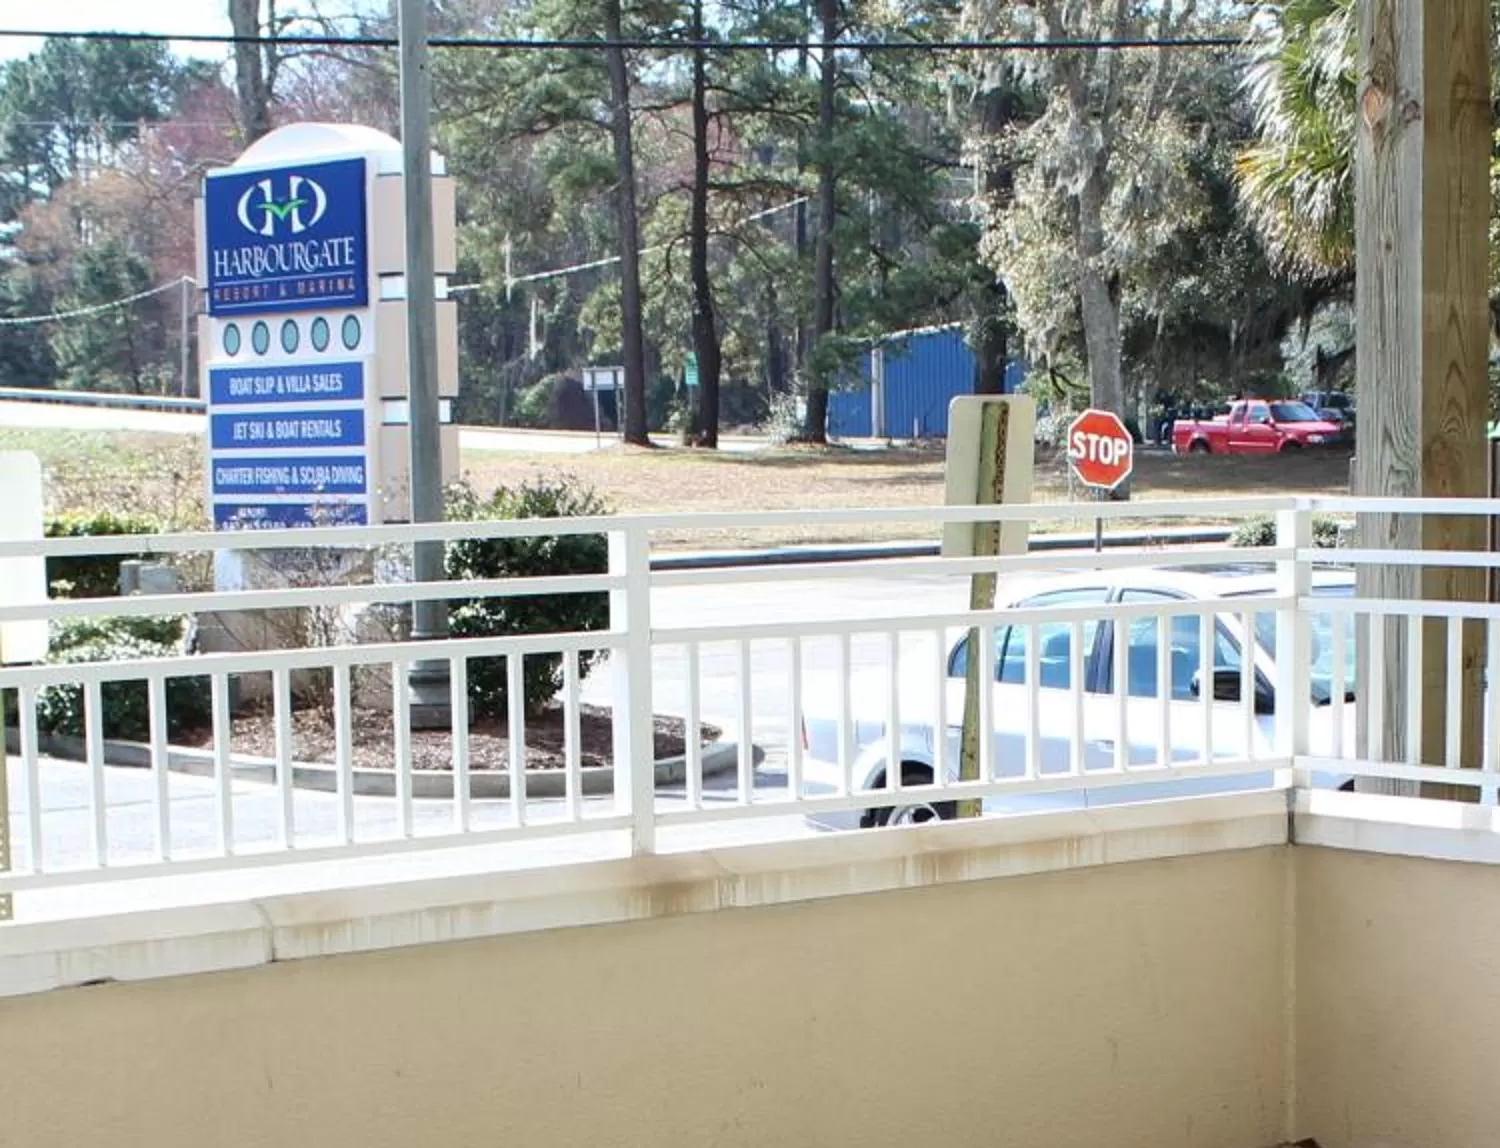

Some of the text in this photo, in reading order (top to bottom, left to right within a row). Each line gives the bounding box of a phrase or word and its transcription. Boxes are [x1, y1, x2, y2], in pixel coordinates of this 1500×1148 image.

[214, 236, 356, 277] HARBOURGATE
[214, 284, 269, 300] RESORT
[297, 277, 355, 294] MARINA
[229, 373, 343, 395] BOAT SLIP & VILLA SALES
[233, 419, 342, 440] JET SKI & BOAT RENTALS
[1072, 431, 1128, 467] STOP
[216, 464, 364, 485] CHARTER FISHING & SCUBA DIVING
